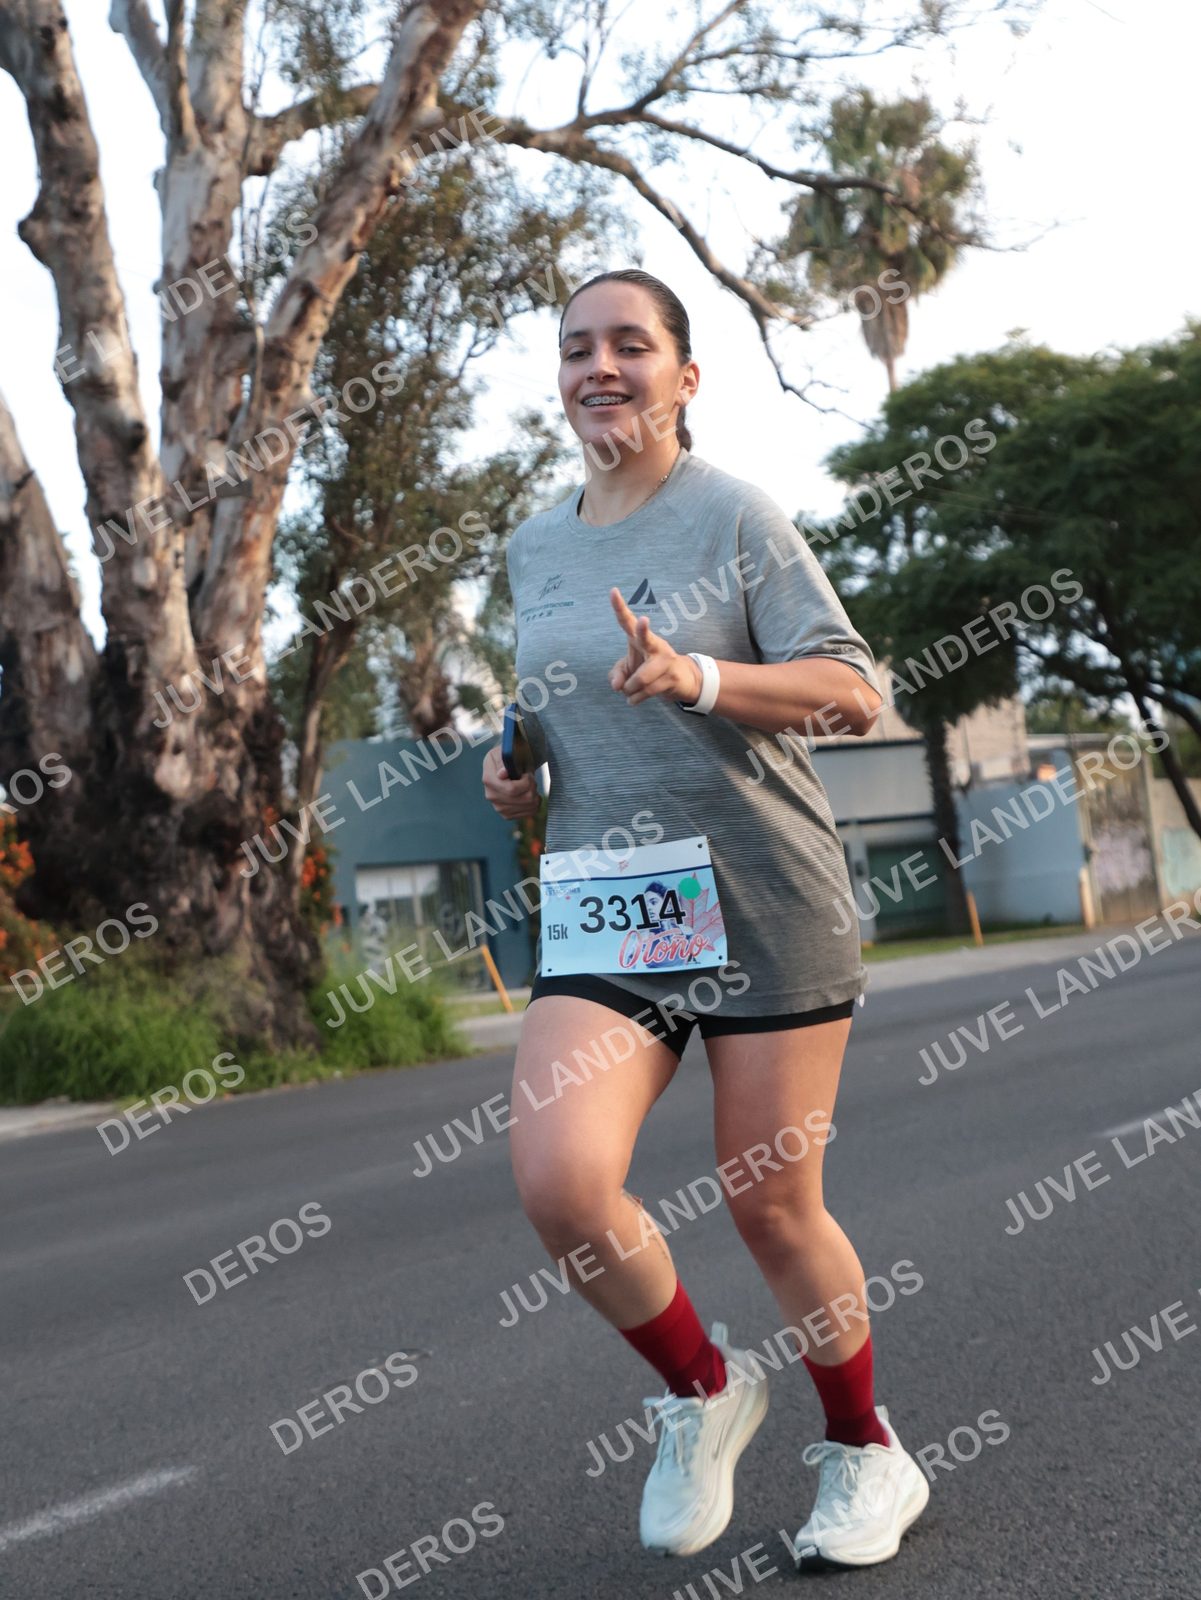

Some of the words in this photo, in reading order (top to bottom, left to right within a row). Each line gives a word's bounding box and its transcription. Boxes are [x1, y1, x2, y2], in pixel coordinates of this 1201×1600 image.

[547, 923, 568, 940] 15k
[579, 890, 686, 933] 3314
[618, 928, 708, 969] Otoño
